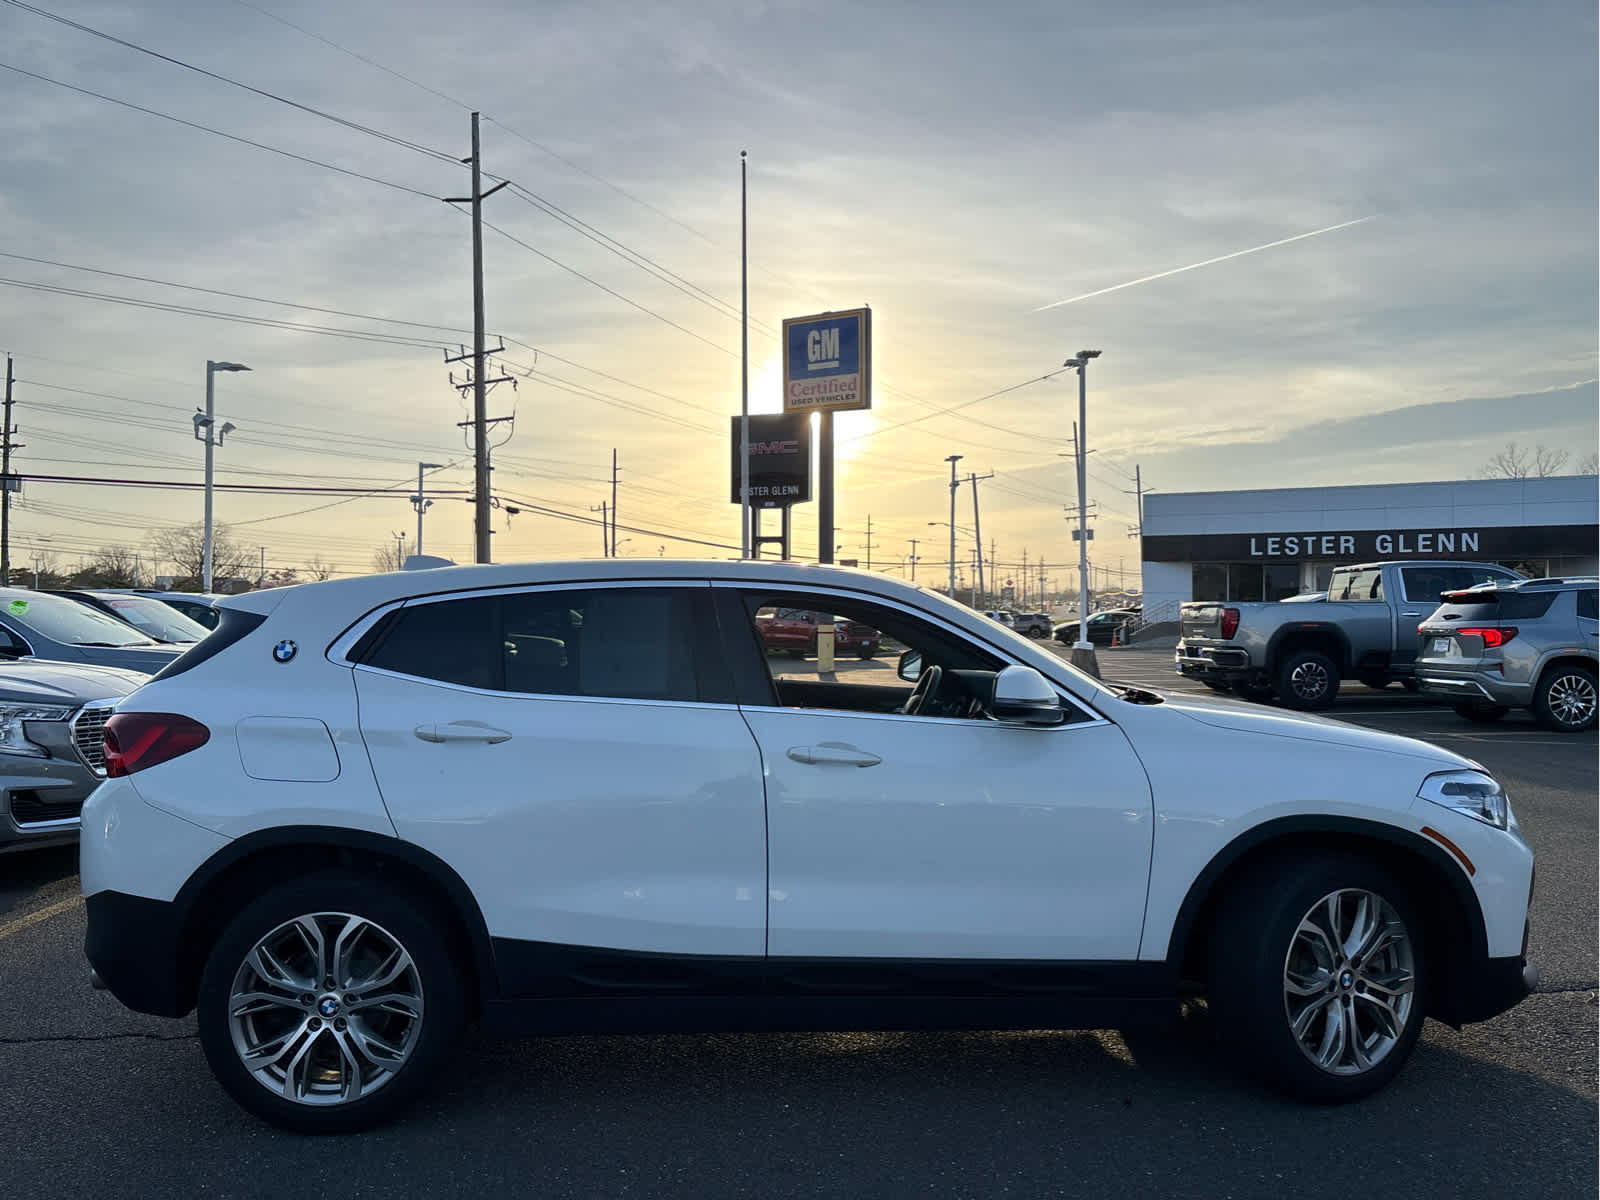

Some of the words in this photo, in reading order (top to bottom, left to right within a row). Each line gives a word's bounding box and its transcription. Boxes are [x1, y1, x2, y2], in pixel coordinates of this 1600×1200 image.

[808, 328, 839, 362] GM
[791, 377, 857, 397] Certified
[791, 396, 814, 405] USED
[815, 393, 857, 403] VEHICLES
[771, 485, 799, 496] GLENN
[1250, 536, 1355, 556] LESTER
[1375, 532, 1479, 554] GLENN
